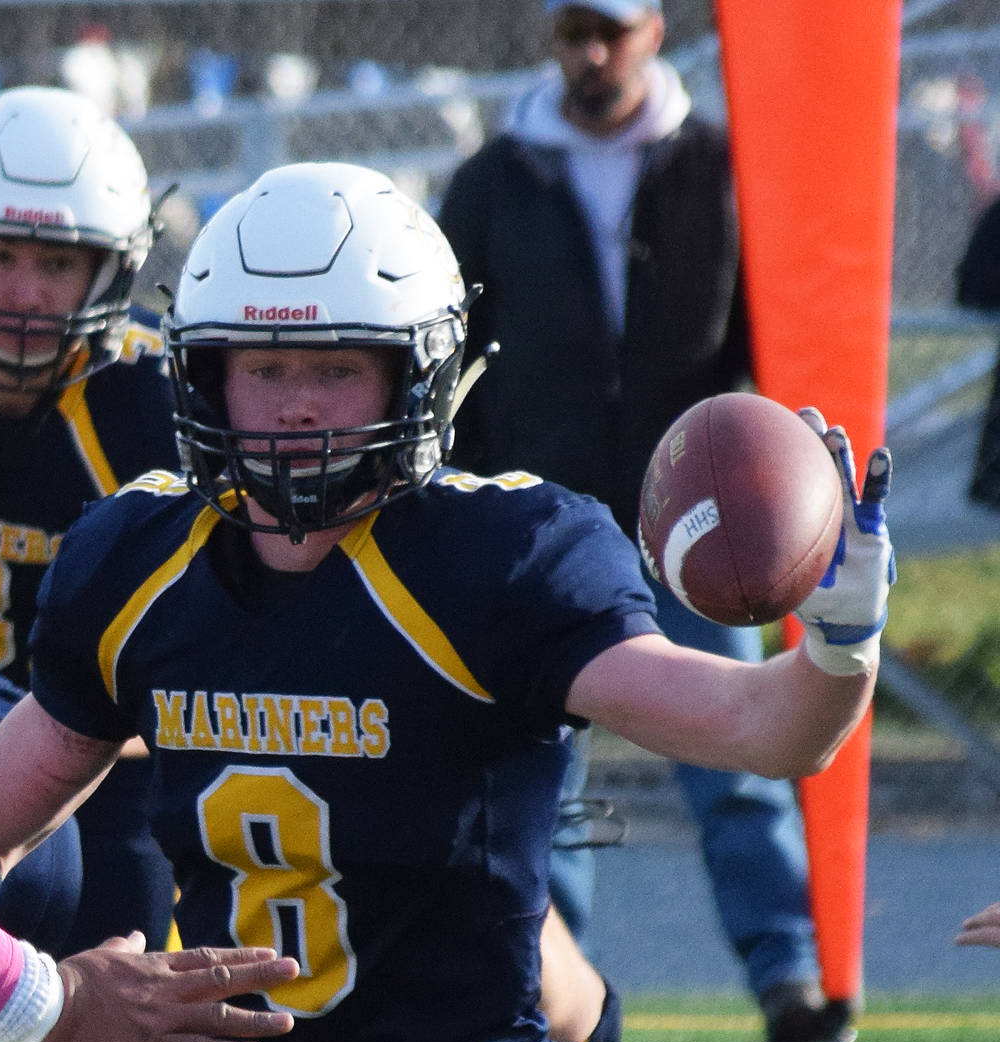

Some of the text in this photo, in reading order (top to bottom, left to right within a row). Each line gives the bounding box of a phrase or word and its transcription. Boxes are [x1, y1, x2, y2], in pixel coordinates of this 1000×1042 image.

[244, 304, 318, 320] Riddell
[152, 690, 391, 758] MARINERS
[197, 765, 358, 1019] 8
